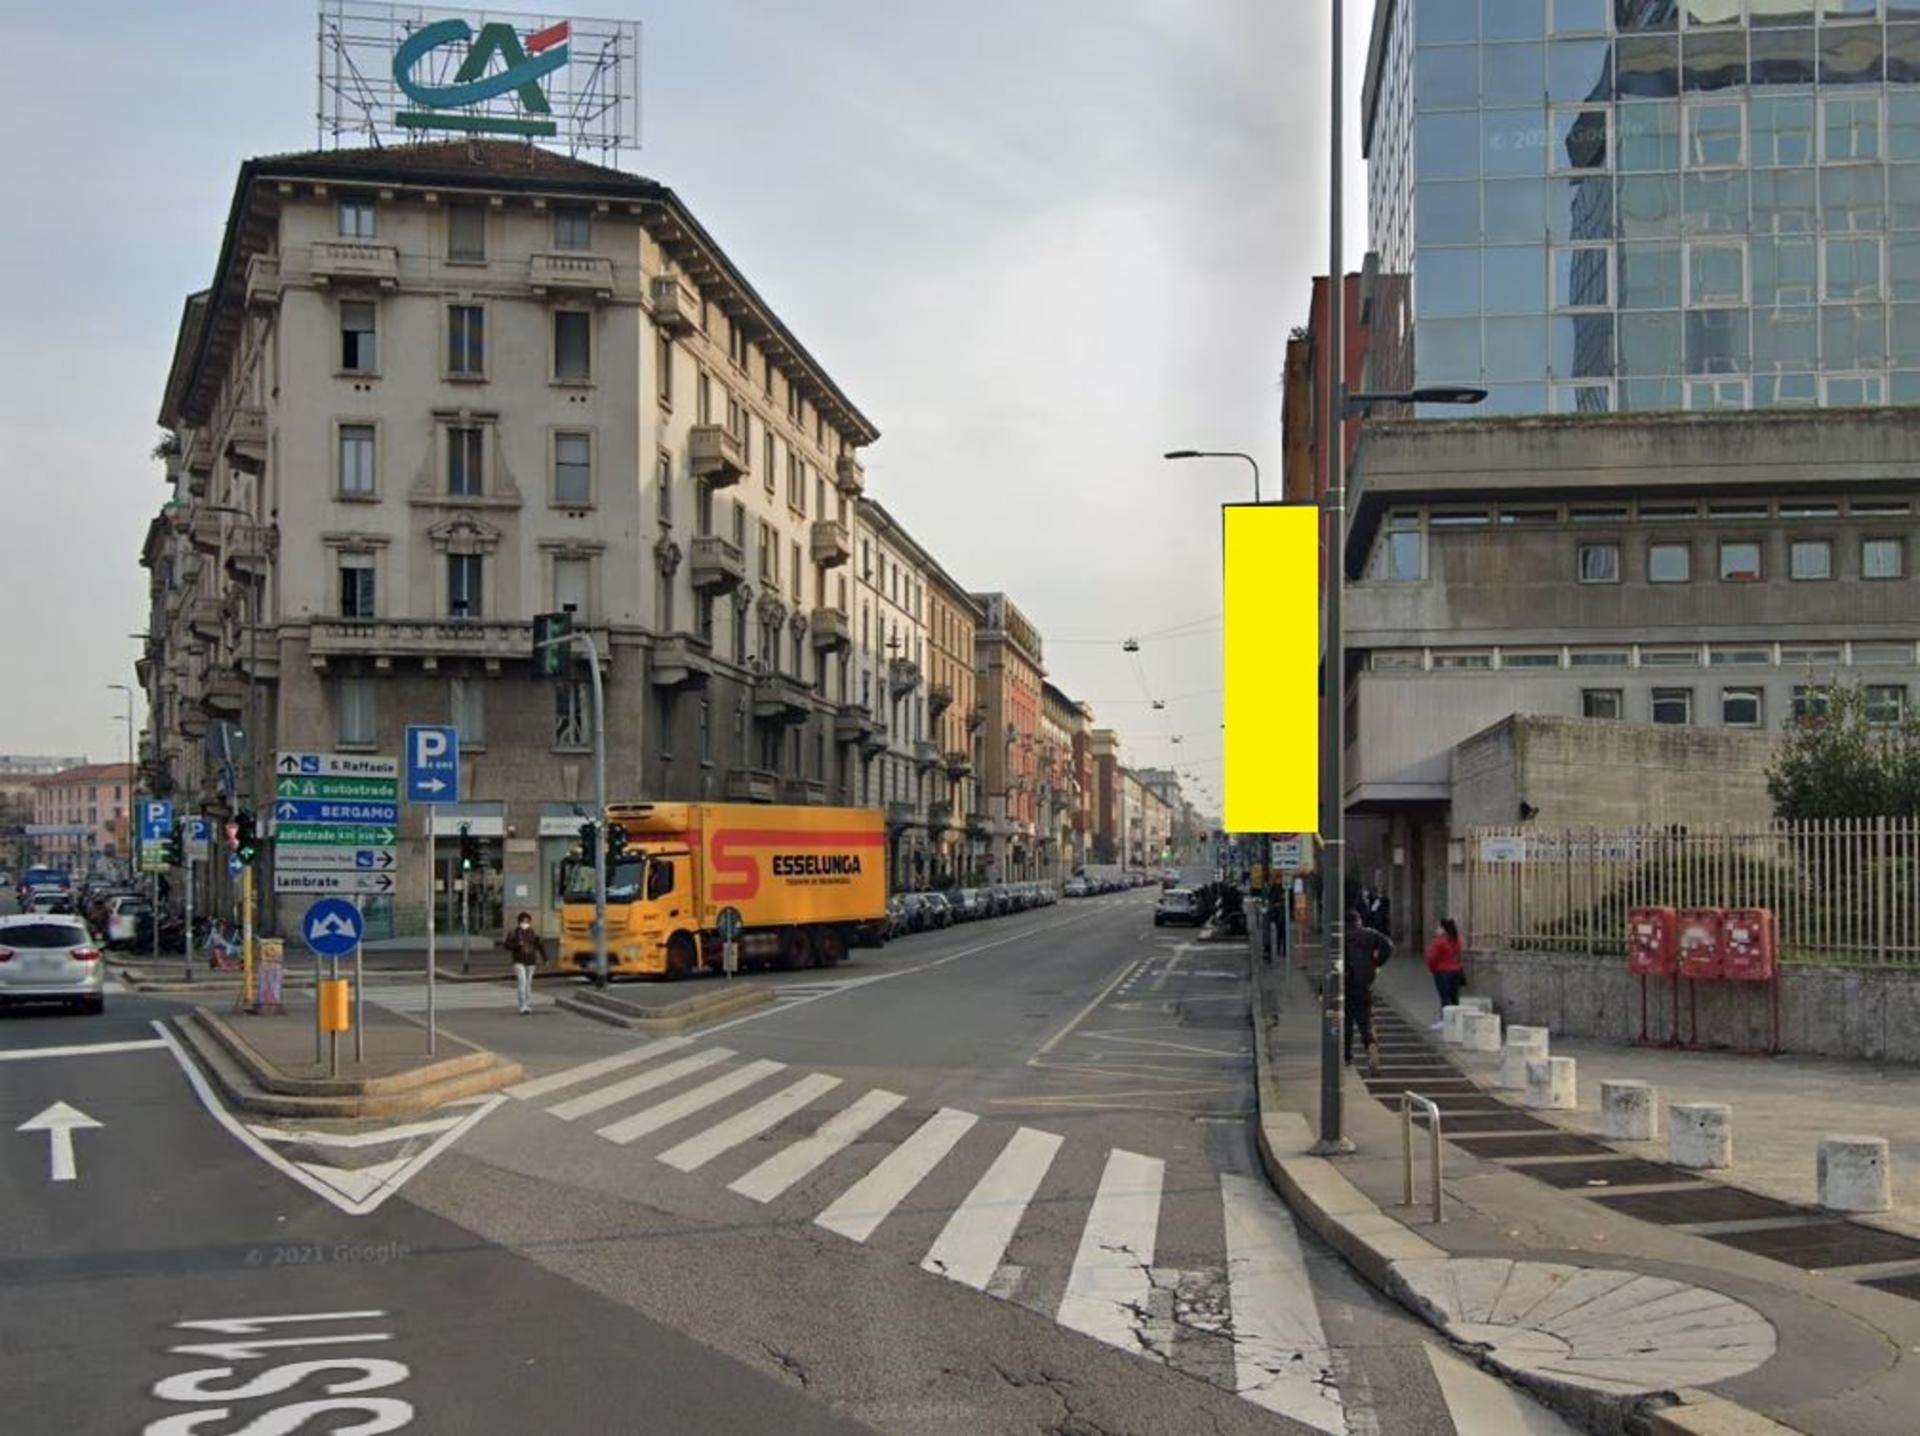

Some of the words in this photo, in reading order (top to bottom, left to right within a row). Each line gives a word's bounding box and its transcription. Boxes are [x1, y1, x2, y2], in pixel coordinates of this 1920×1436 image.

[393, 19, 569, 113] CA
[417, 731, 446, 768] P
[322, 783, 395, 796] autostrade
[147, 802, 165, 823] P
[320, 805, 395, 820] BERGAMO
[772, 854, 862, 876] ESSELUNGA
[277, 875, 340, 888] Lambrate
